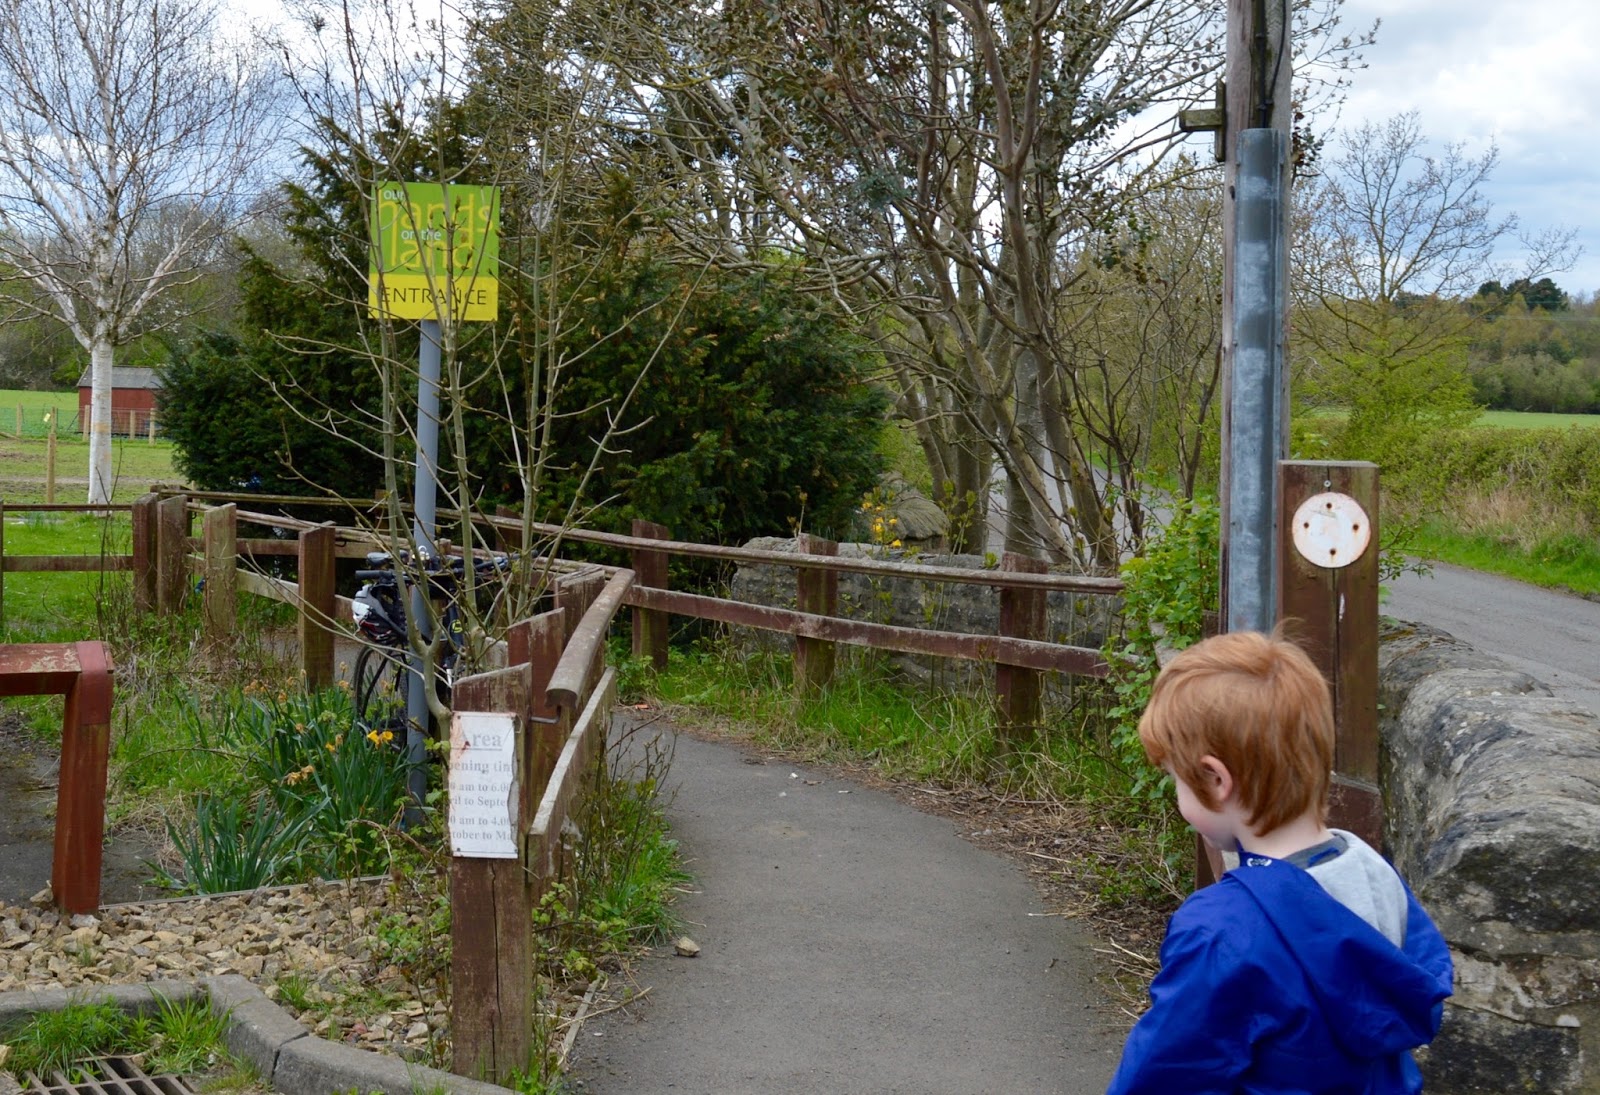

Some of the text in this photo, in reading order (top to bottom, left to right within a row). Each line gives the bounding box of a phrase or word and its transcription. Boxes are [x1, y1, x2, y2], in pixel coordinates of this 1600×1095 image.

[383, 190, 406, 200] our
[378, 188, 494, 233] hands
[421, 229, 442, 240] the
[478, 783, 488, 792] to
[464, 797, 474, 806] to
[478, 816, 488, 826] to
[482, 831, 492, 841] to
